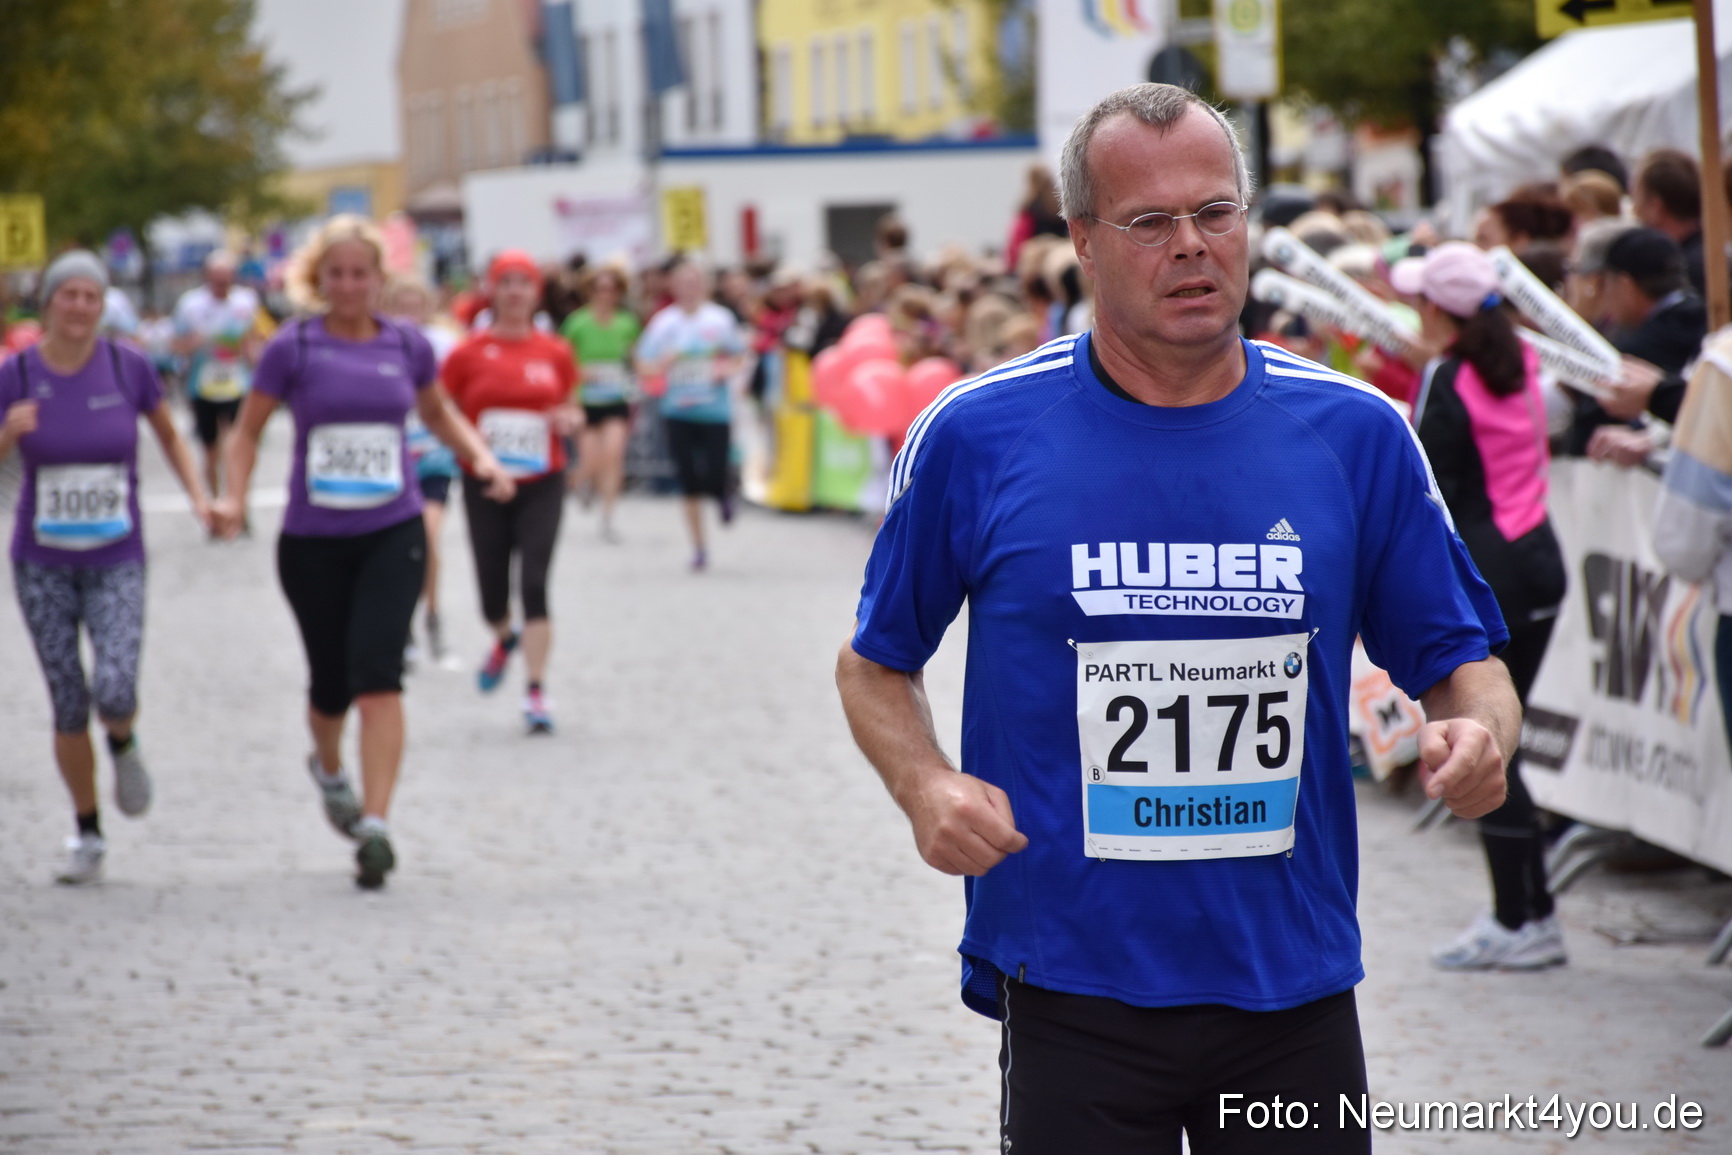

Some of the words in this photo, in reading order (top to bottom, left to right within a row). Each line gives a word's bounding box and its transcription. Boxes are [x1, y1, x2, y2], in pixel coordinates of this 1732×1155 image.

[47, 488, 120, 517] 3009
[1266, 532, 1301, 541] adidas
[1071, 542, 1304, 591] HUBER
[1123, 594, 1296, 613] TECHNOLOGY
[1085, 663, 1163, 682] PARTL
[1169, 660, 1276, 682] Neumarkt
[1106, 691, 1291, 773] 2175
[1092, 768, 1100, 781] B
[1134, 795, 1267, 828] Christian
